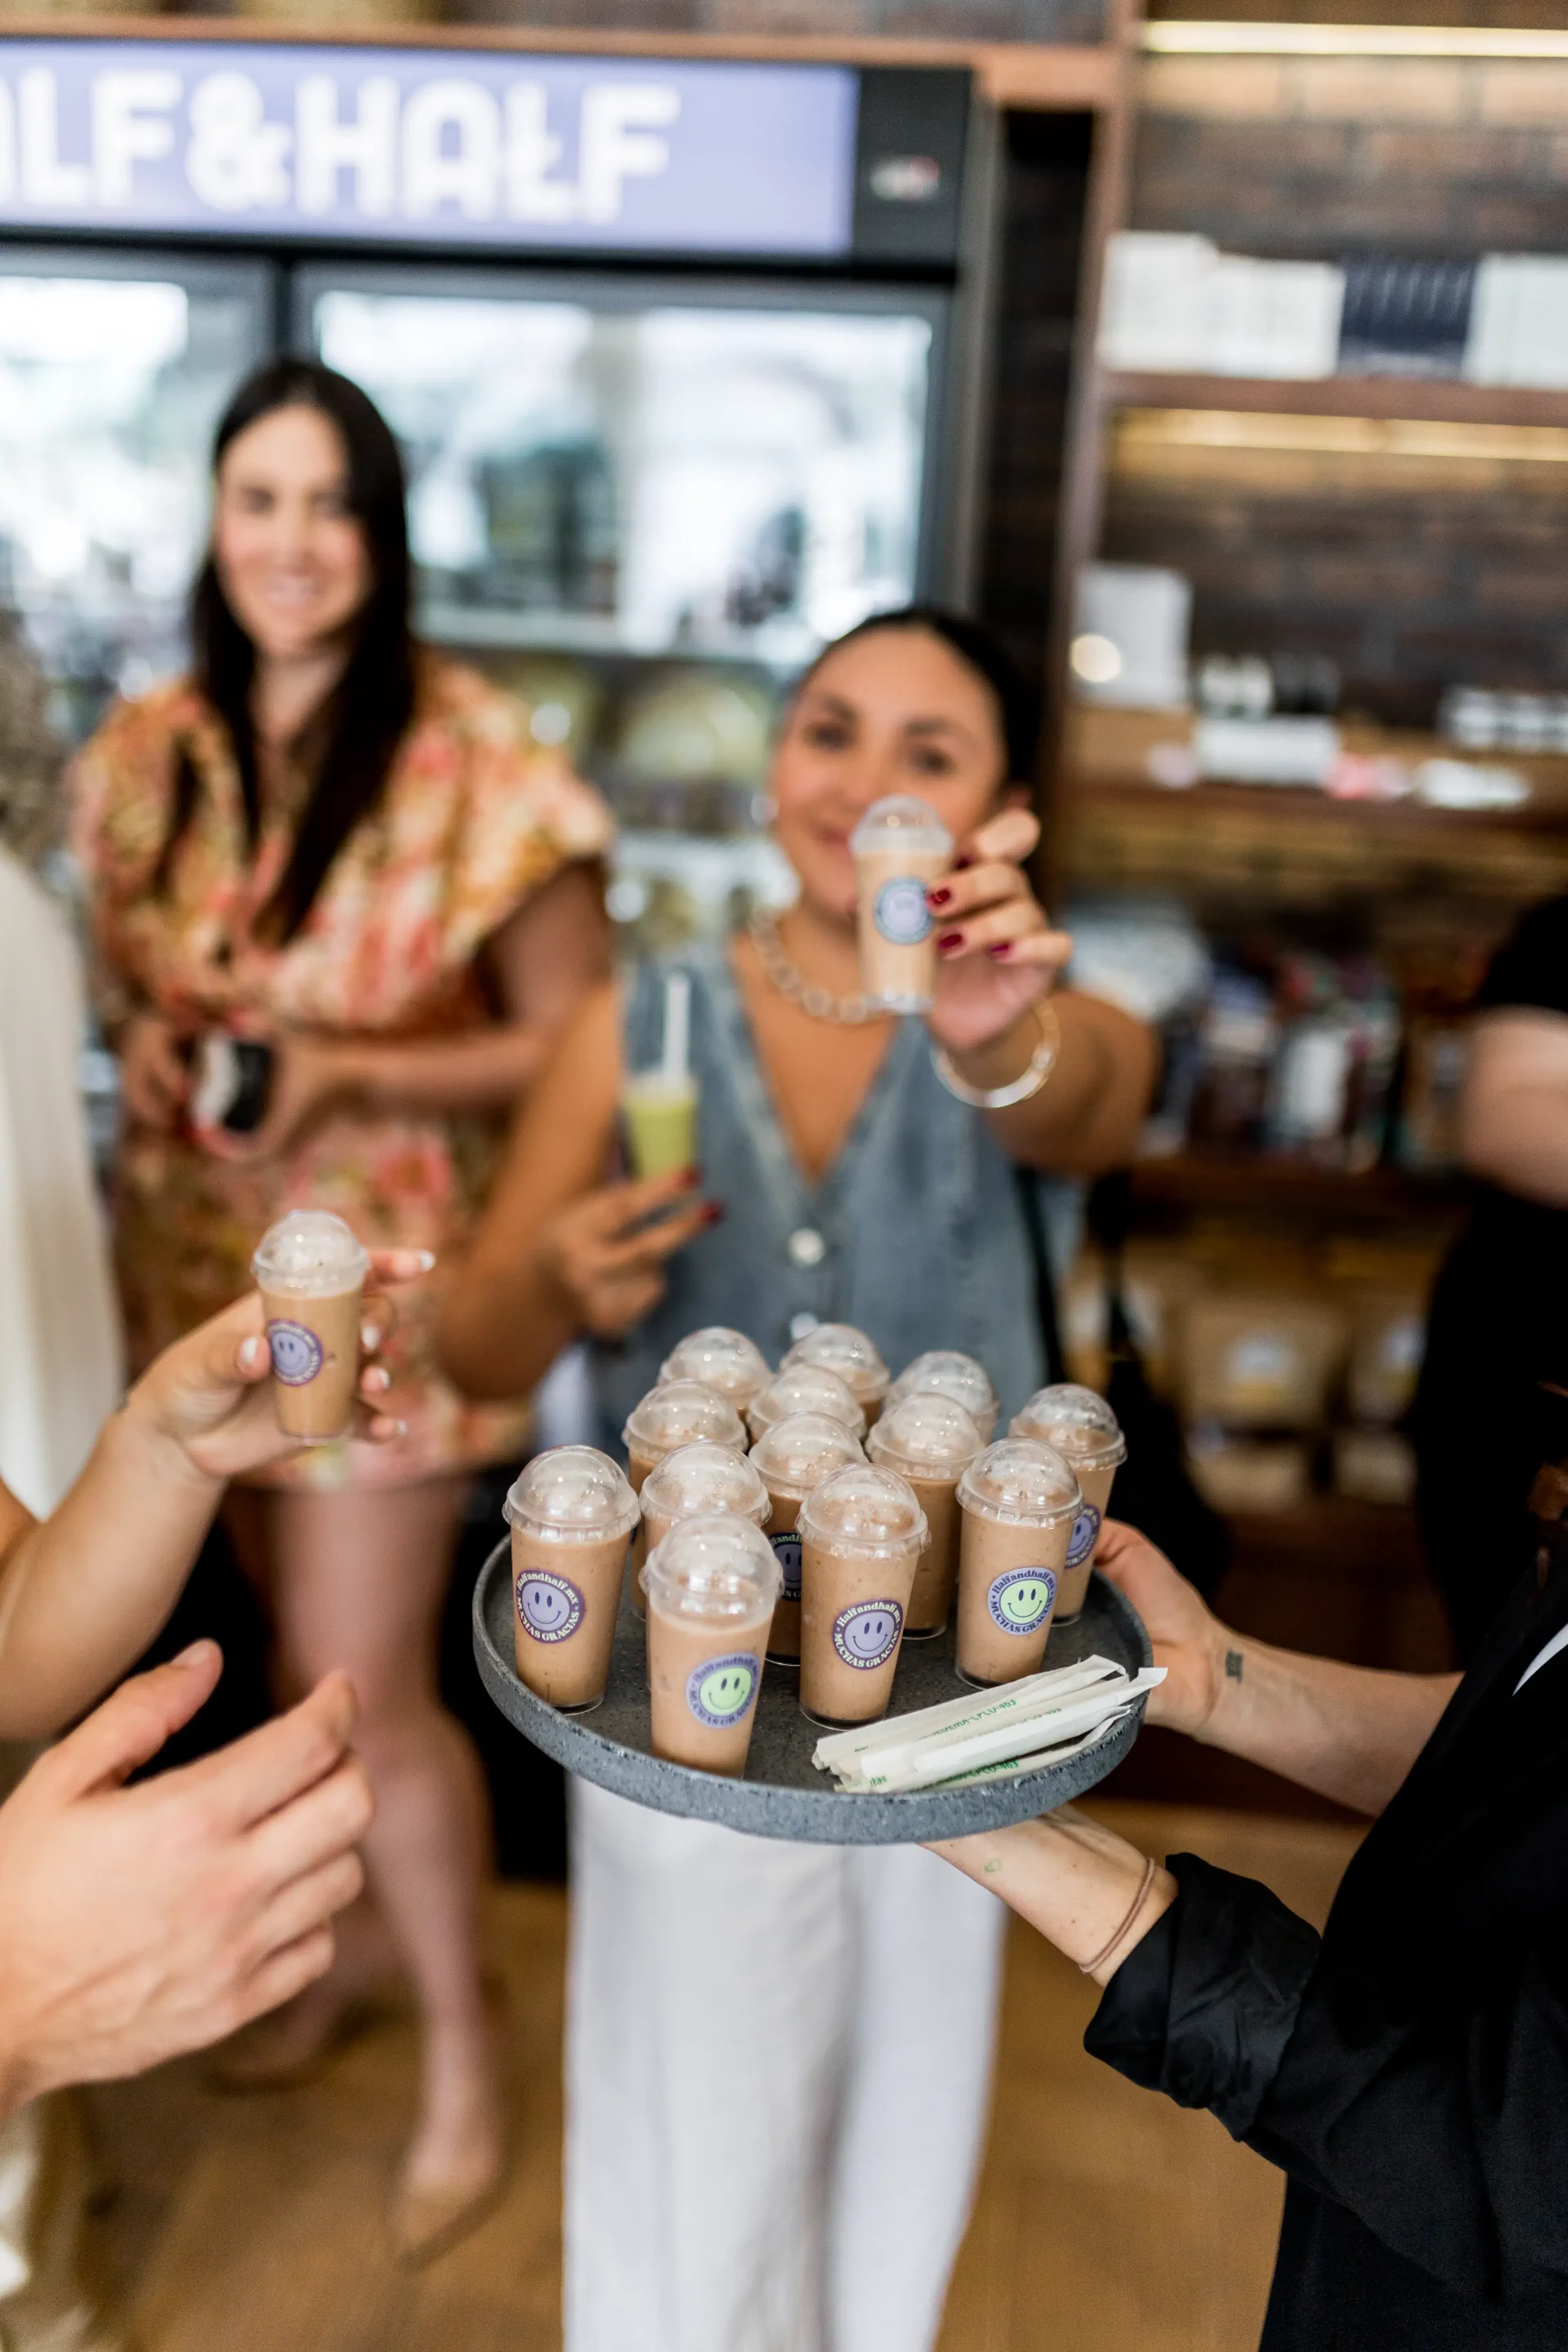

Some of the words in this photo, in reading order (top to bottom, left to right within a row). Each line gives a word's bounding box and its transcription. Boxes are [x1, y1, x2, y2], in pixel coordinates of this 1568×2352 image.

[541, 1611, 580, 1641] GRACIAS
[990, 1601, 1020, 1633] MUCHAS
[1022, 1596, 1054, 1633] GRACIAS
[834, 1633, 865, 1668] MUCHAS
[865, 1630, 899, 1668] GRACIAS
